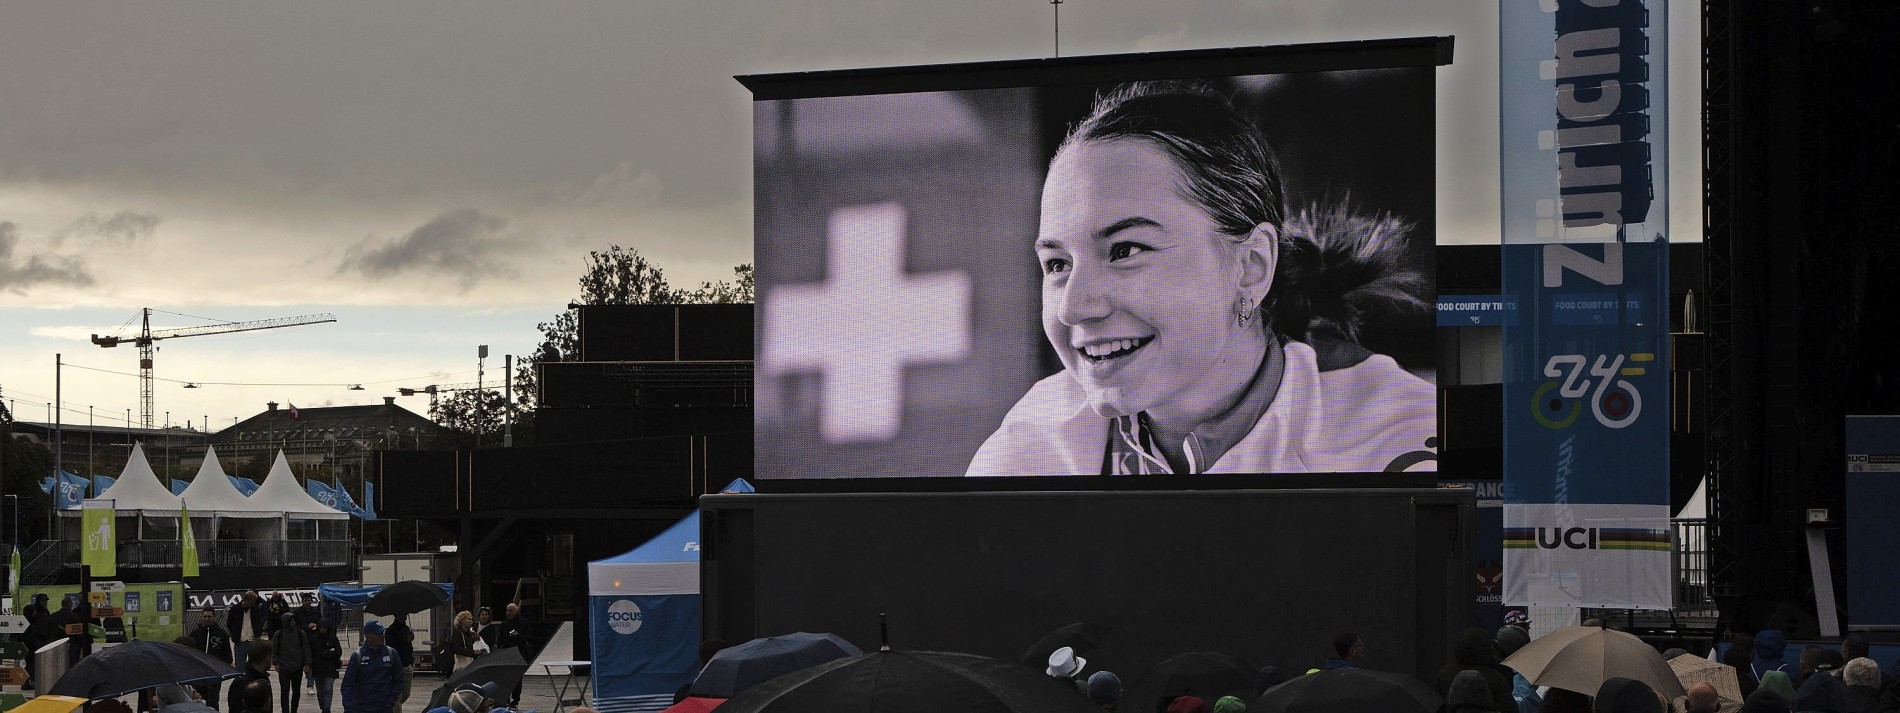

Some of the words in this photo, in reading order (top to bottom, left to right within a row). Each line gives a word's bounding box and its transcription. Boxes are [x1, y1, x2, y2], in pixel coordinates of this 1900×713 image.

[1536, 27, 1623, 289] Zürich
[1455, 302, 1480, 311] COURT
[1481, 302, 1491, 311] BY
[1851, 455, 1868, 463] UCI
[1538, 527, 1597, 550] UCI
[608, 612, 643, 621] FOCUS
